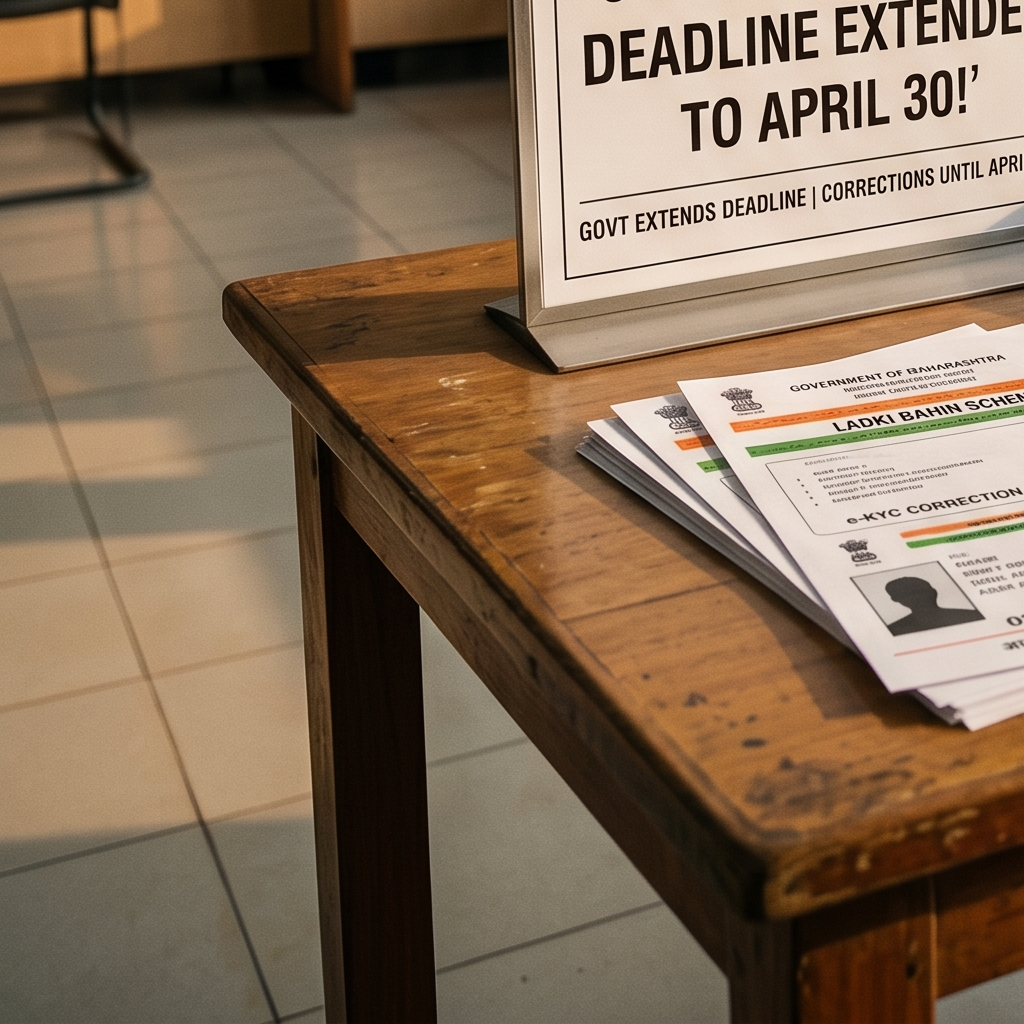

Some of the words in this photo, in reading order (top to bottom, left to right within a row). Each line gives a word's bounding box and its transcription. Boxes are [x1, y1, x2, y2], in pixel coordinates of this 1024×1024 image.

[583, 10, 819, 87] DEADLINE
[680, 97, 742, 152] TO
[758, 79, 890, 143] APRIL
[579, 216, 629, 242] GOVT
[635, 203, 717, 233] EXTENDS
[722, 188, 807, 219] DEADLINE
[822, 168, 935, 203] CORRECTIONS
[940, 159, 985, 184] UNTIL
[789, 371, 884, 393] GOVERNMENT
[886, 369, 903, 378] OF
[832, 413, 896, 433] LADKI
[898, 403, 963, 423] BAHIN
[906, 487, 1023, 516] CORRECTION
